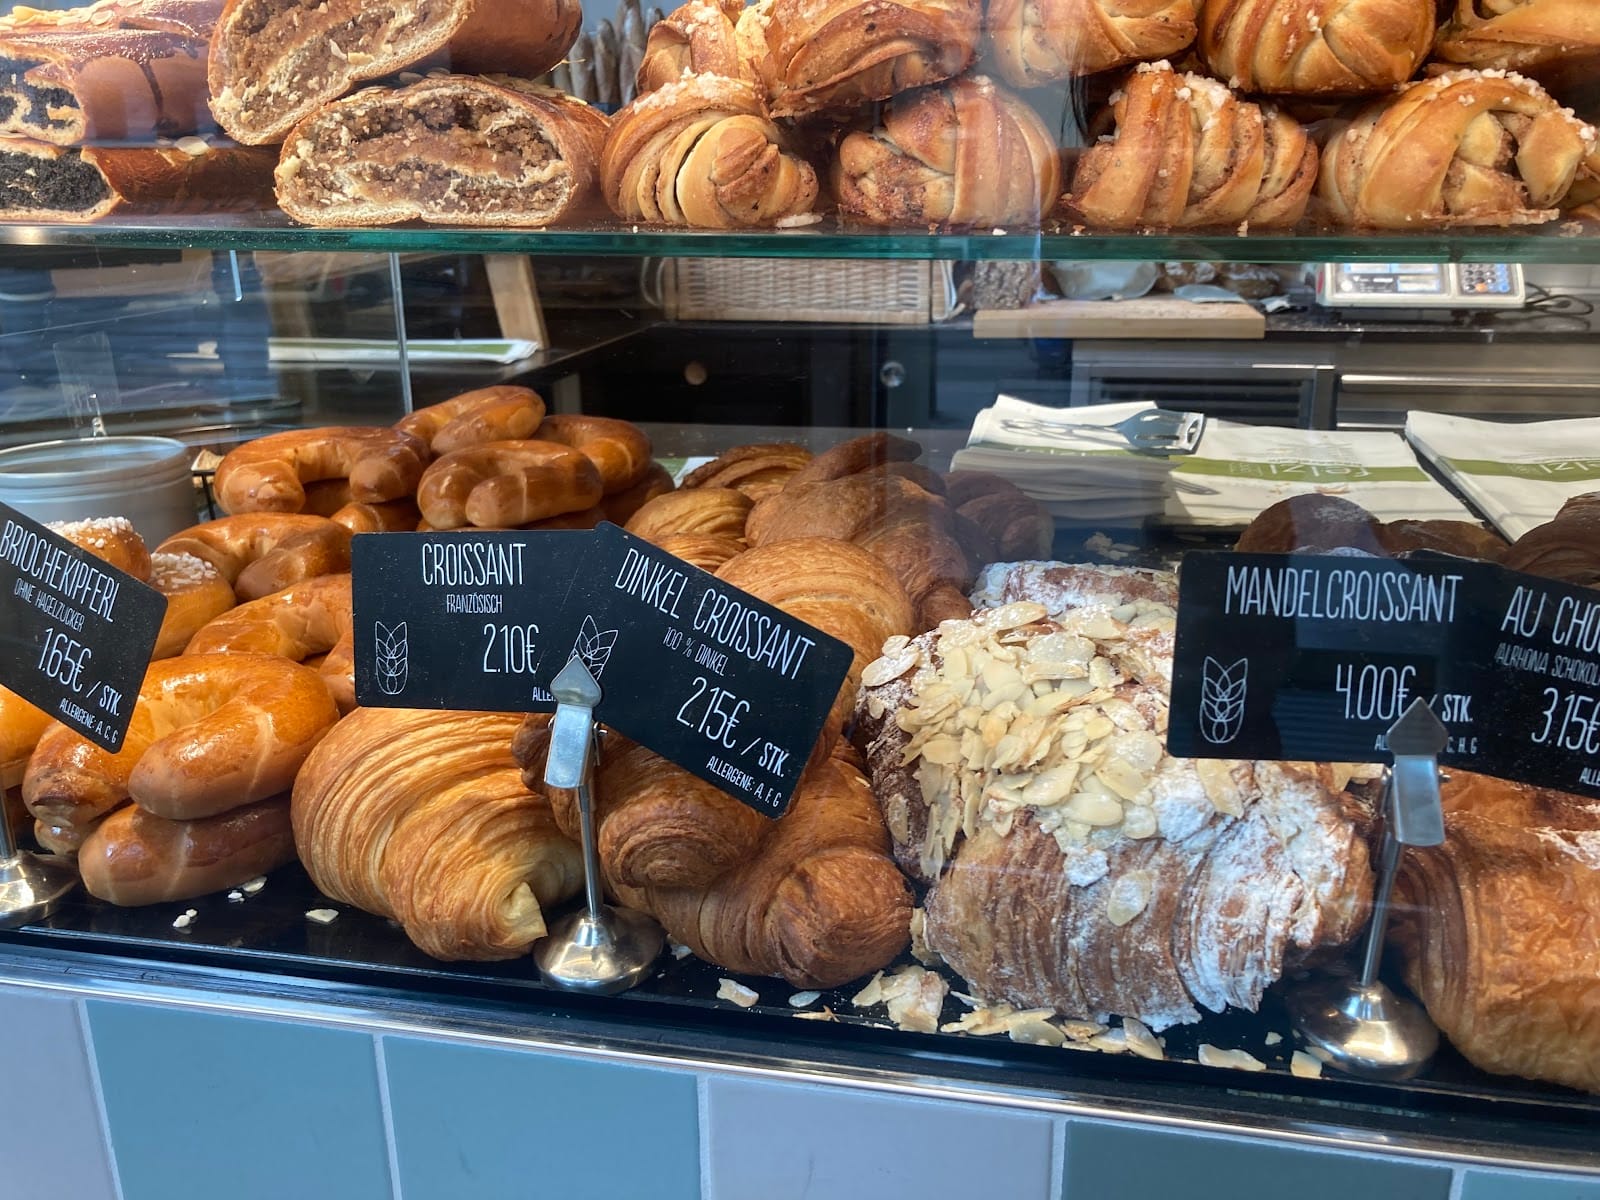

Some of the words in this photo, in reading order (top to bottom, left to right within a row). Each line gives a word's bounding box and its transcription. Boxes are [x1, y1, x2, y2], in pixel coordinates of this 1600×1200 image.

[0, 519, 120, 623] BRIOCHEKIPFERL
[422, 542, 527, 586] CROISSANT
[14, 577, 37, 604] OHNE
[35, 589, 86, 633] HAGELZUCKER
[446, 592, 503, 614] FRANZÖSISCH
[614, 547, 689, 620] DINKEL
[692, 587, 816, 681] CROISSANT
[1224, 565, 1464, 623] MANDELCROISSANT
[1500, 585, 1547, 638] AU
[1552, 596, 1600, 655] CHO
[482, 622, 540, 675] 2.10€
[662, 626, 684, 651] 100
[681, 637, 695, 657] %
[694, 642, 730, 677] DINKEL
[1551, 654, 1600, 687] SCHOKOL
[59, 697, 97, 729] ALLERGENE:
[86, 679, 102, 699] /
[99, 684, 123, 717] STK.
[1335, 663, 1417, 721] 4.00€
[1441, 692, 1474, 723] STK.
[676, 675, 750, 750] 2.15€
[740, 737, 762, 756] /
[758, 741, 790, 778] STK.
[705, 755, 756, 792] ALLERGENE:
[772, 791, 782, 808] G
